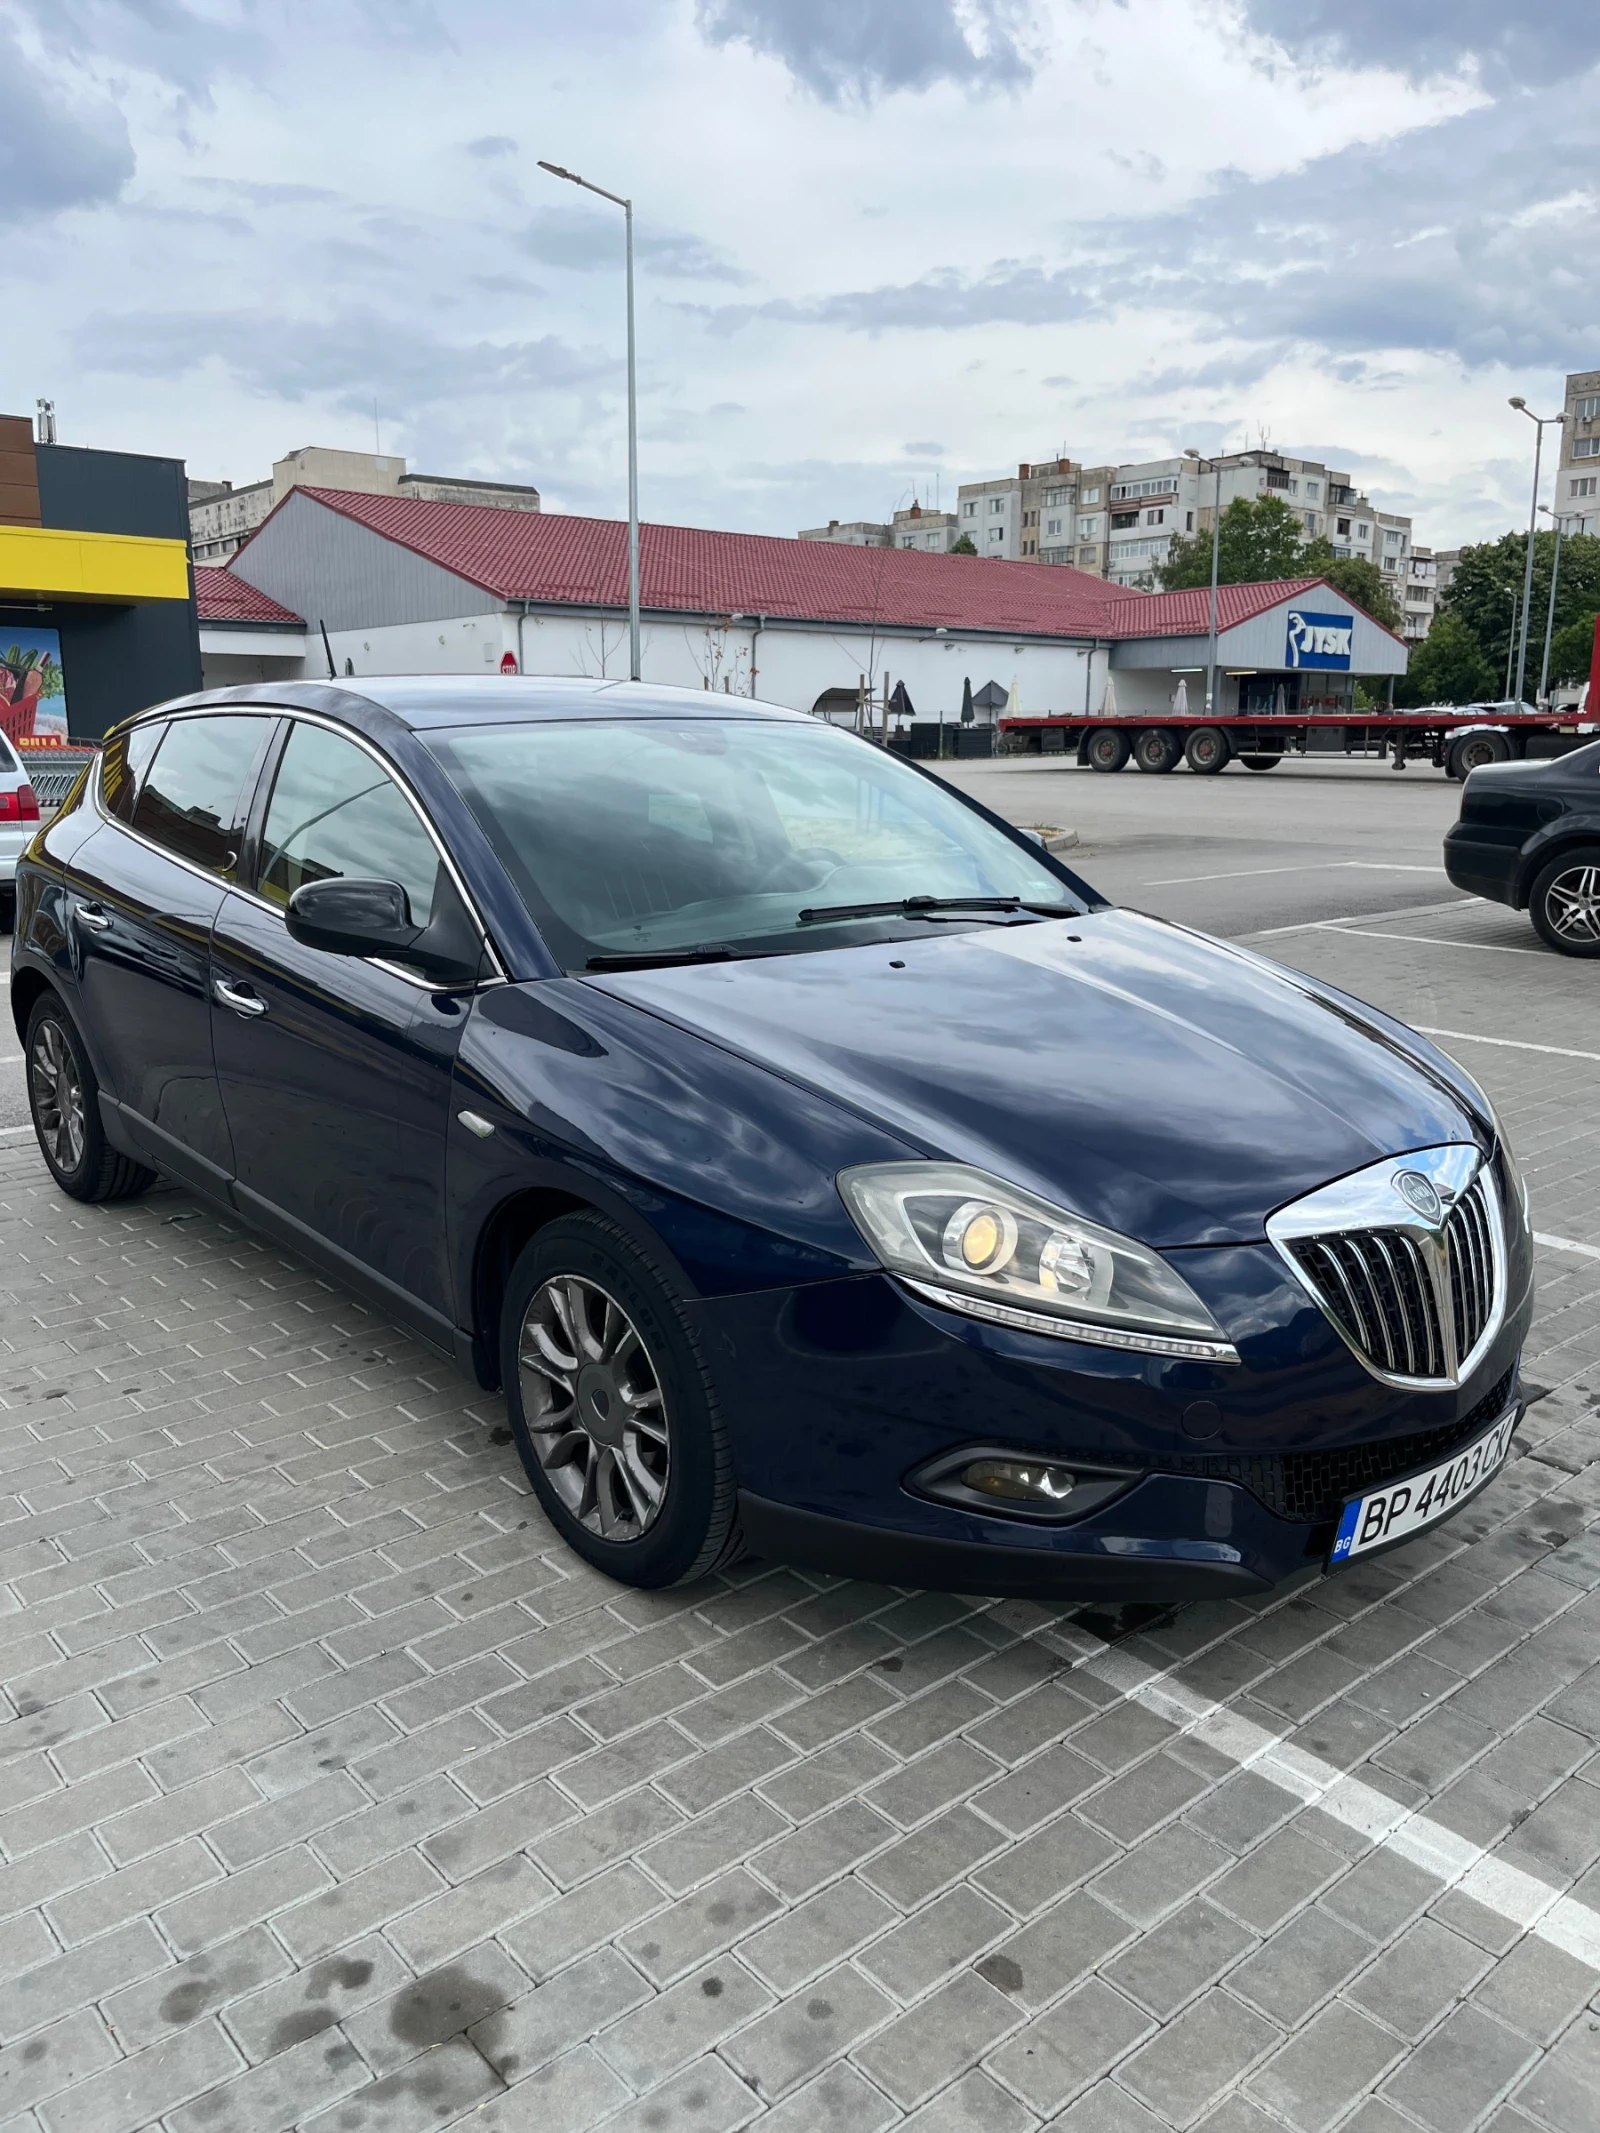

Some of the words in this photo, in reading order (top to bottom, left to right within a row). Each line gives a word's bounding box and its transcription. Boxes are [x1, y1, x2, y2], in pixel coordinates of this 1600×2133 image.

[1300, 625, 1352, 655] JYSK
[1407, 1185, 1432, 1202] LANCIA
[1358, 1487, 1411, 1545] BP
[1414, 1445, 1482, 1518] 4403
[1334, 1536, 1351, 1553] BG
